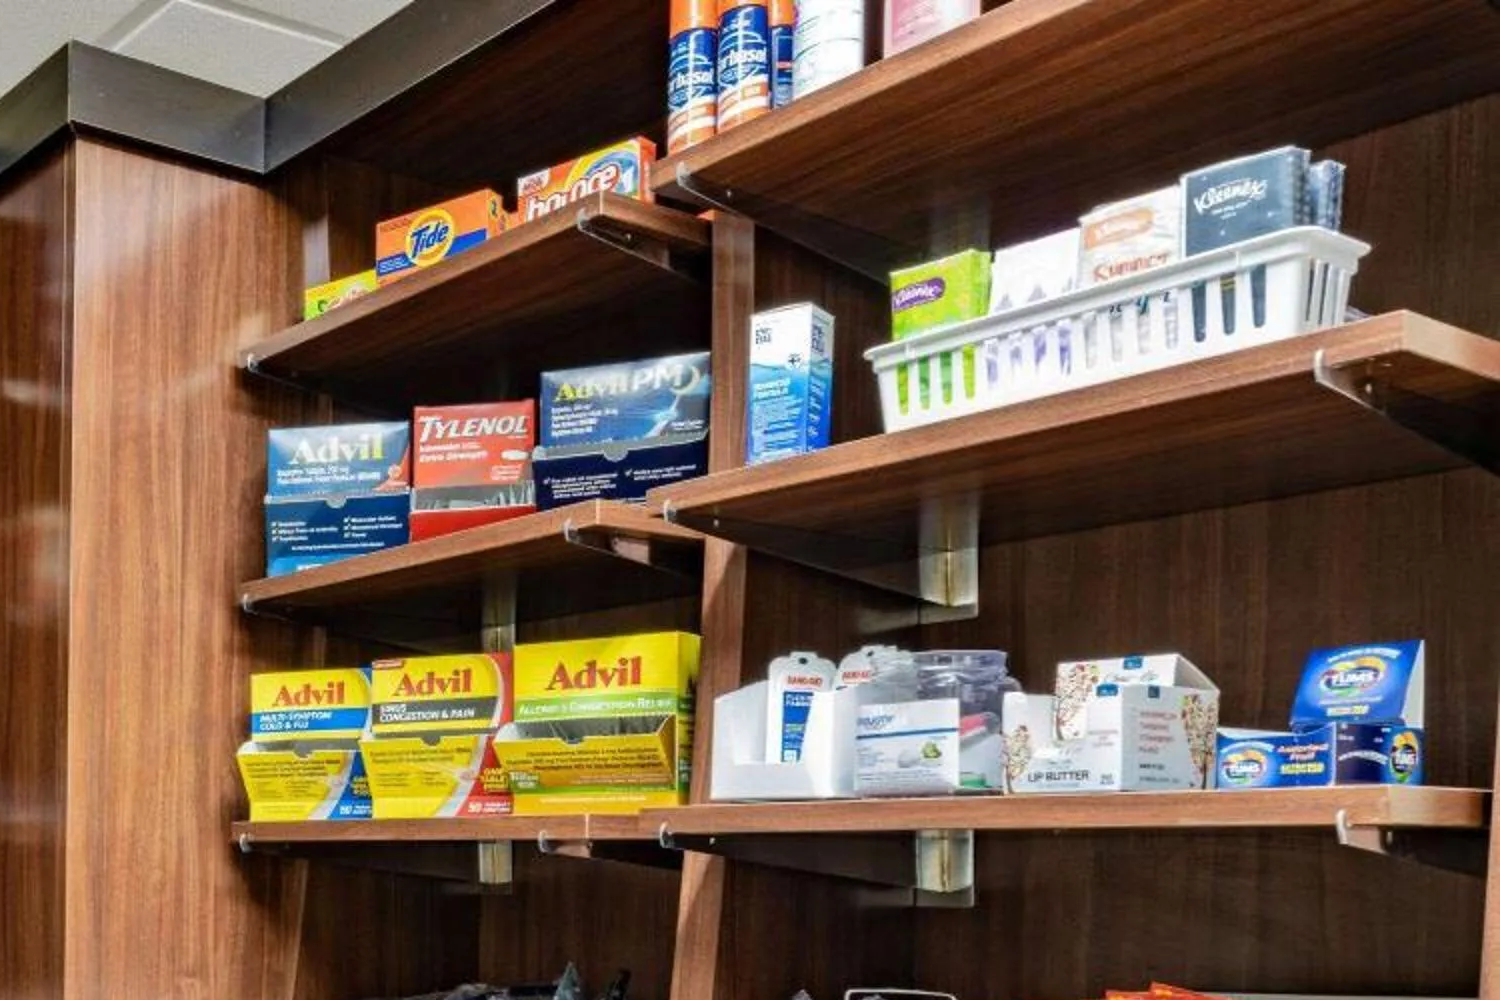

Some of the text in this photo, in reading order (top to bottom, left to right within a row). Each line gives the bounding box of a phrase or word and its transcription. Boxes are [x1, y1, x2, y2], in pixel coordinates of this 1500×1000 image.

[1194, 179, 1268, 215] Kleenex
[410, 221, 450, 255] Tide
[419, 415, 528, 441] TYLENOL
[288, 432, 385, 465] Advil
[394, 669, 473, 697] Advil
[545, 655, 643, 692] Advil
[272, 681, 346, 707] Advil
[1027, 770, 1089, 783] LIP BUTTER
